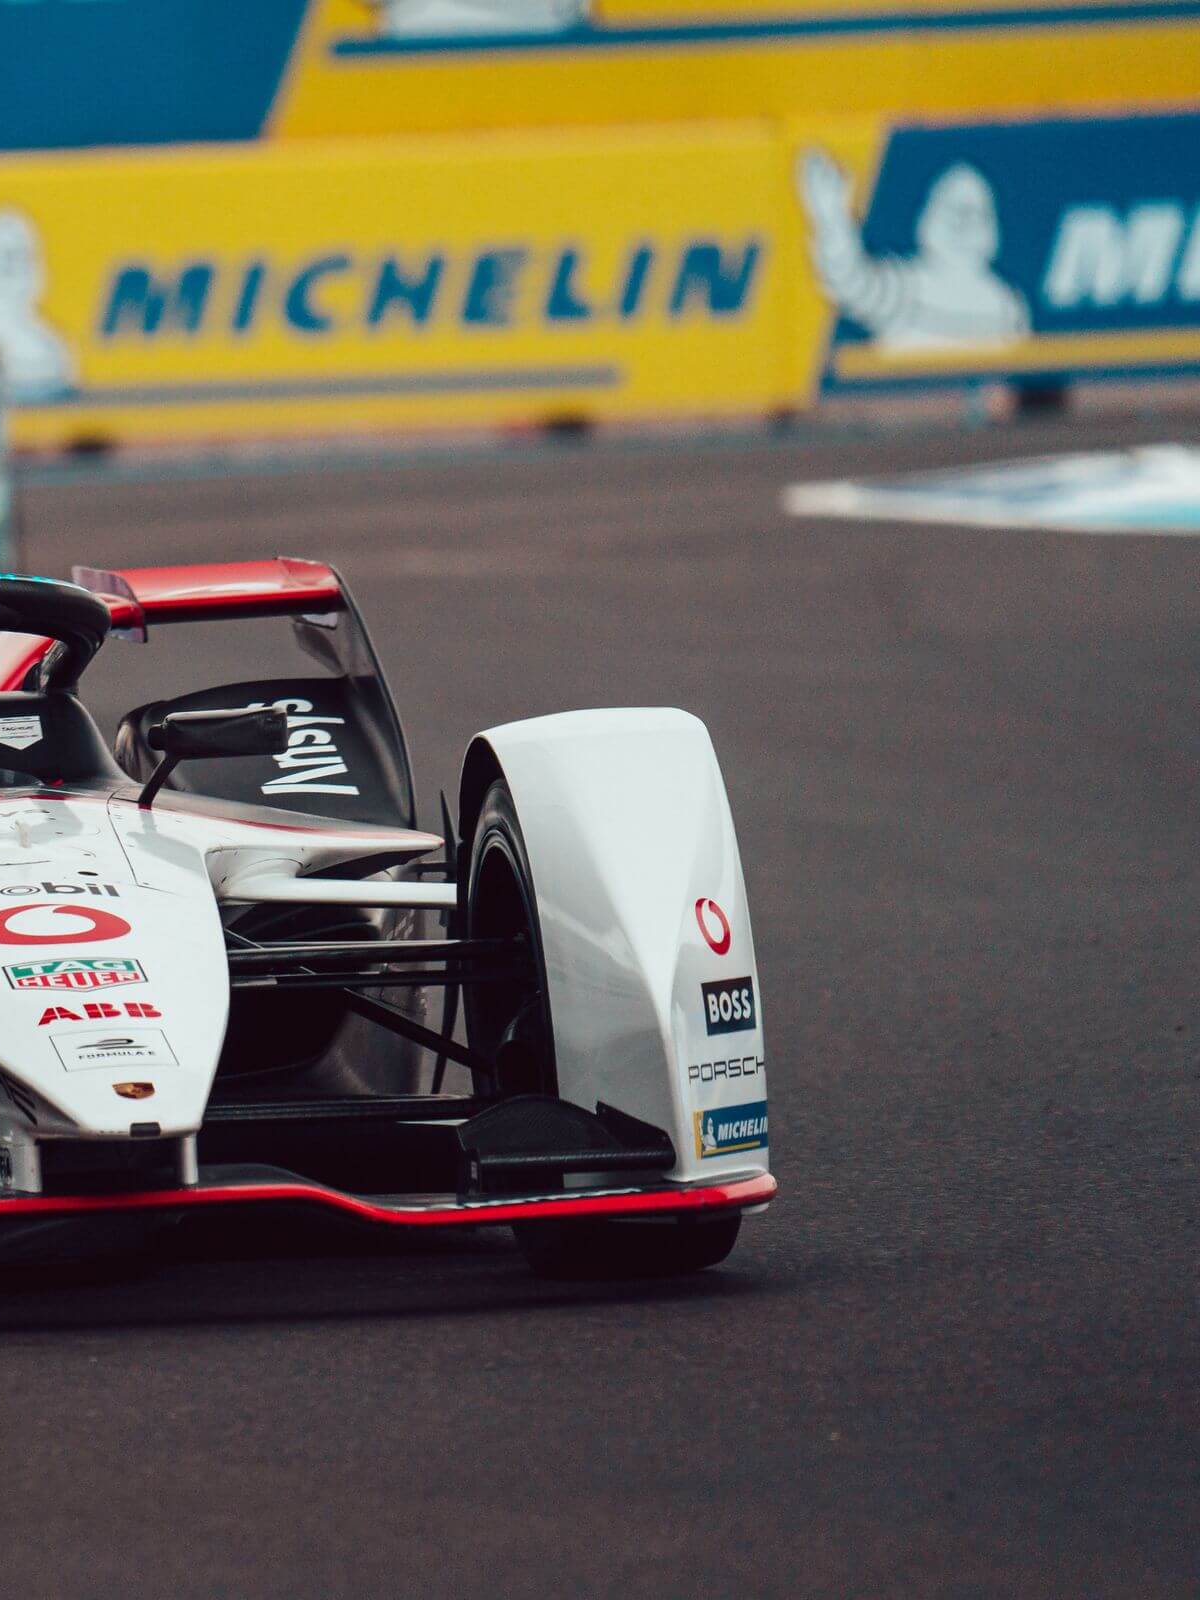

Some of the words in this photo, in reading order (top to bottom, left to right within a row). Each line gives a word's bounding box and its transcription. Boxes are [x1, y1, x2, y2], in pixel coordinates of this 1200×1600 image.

[100, 243, 758, 336] MICHELIN
[17, 960, 130, 975] TAG
[18, 971, 138, 988] HEUER
[38, 1003, 162, 1025] ABB
[707, 988, 752, 1023] BOSS
[78, 1050, 144, 1060] FORMULA
